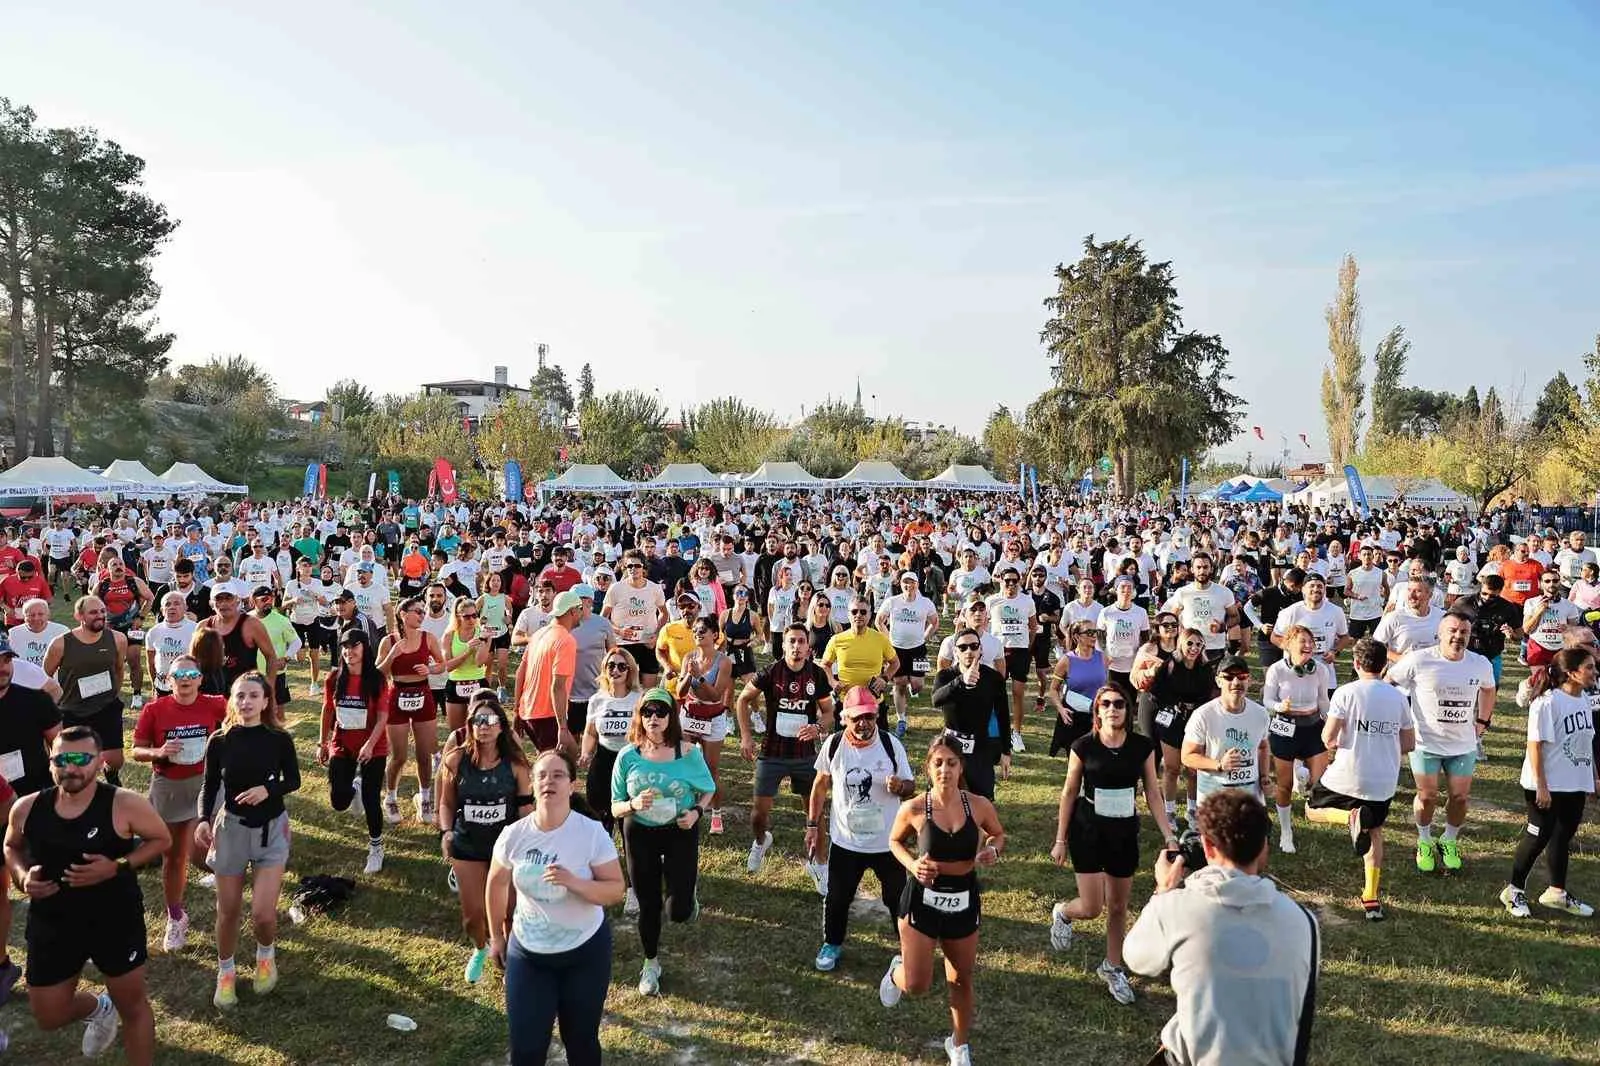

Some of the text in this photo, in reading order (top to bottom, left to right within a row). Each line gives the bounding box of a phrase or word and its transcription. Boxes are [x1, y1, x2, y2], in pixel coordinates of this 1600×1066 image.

[403, 700, 420, 708] 1782
[606, 721, 627, 730] 1780
[689, 721, 706, 731] 202
[1564, 710, 1592, 735] UCL
[1273, 723, 1289, 733] 636
[1228, 770, 1252, 780] 1302
[471, 808, 499, 820] 1466
[933, 896, 960, 908] 1713
